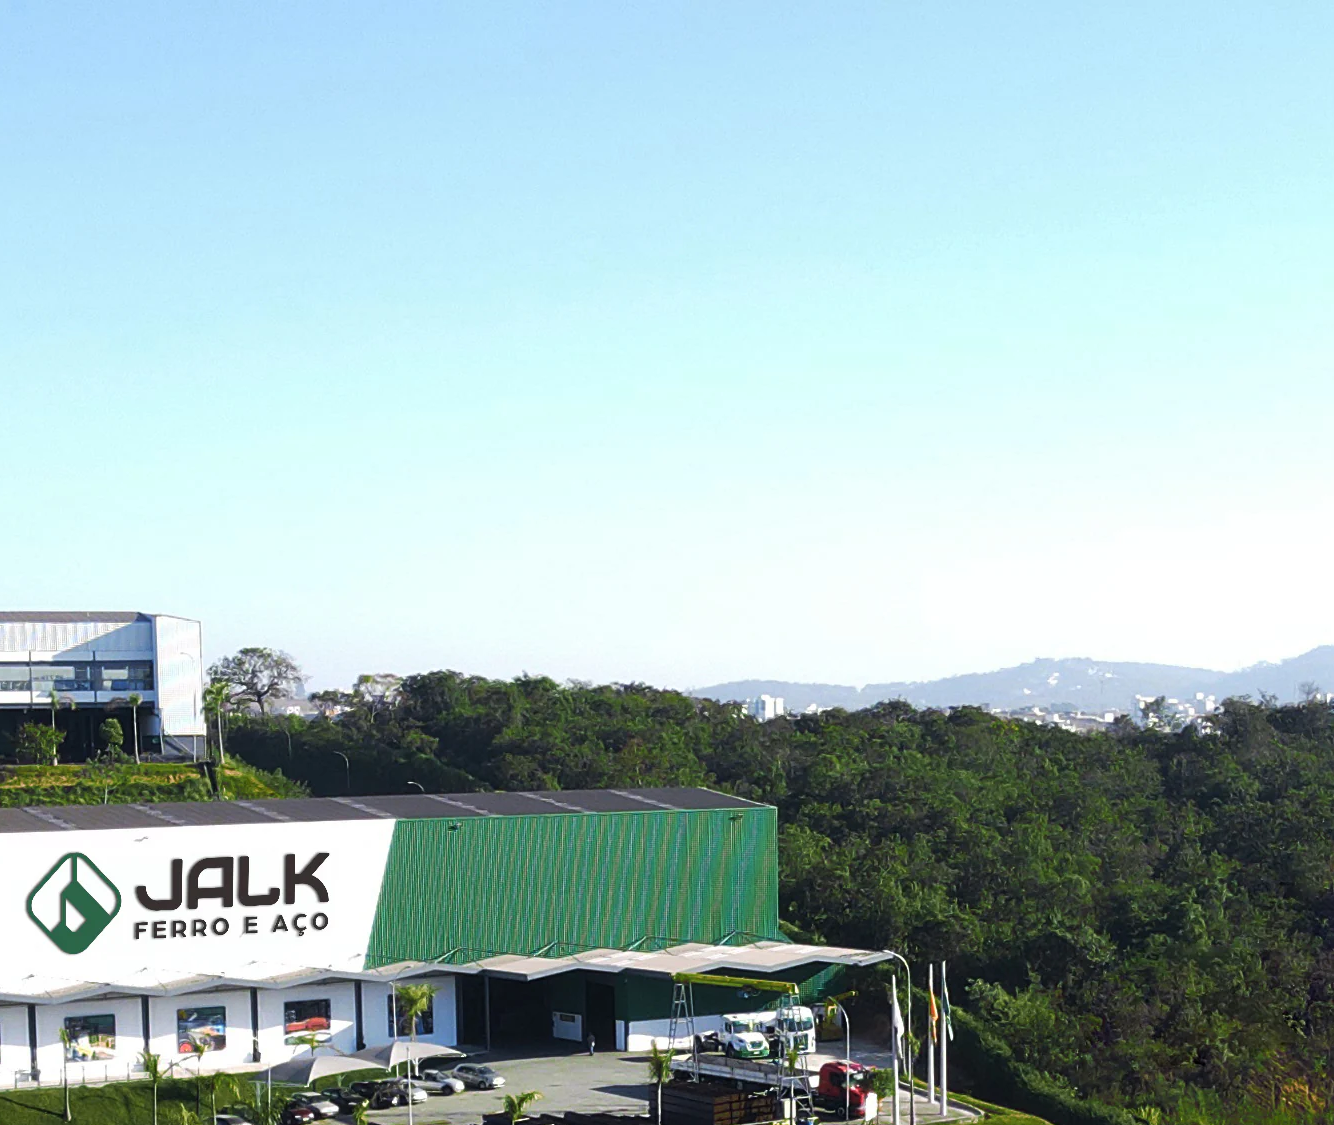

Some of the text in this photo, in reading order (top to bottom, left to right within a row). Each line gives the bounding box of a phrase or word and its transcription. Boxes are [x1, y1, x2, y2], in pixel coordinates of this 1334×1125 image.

[135, 852, 330, 911] JALK
[134, 912, 329, 940] FERRO E AÇO
